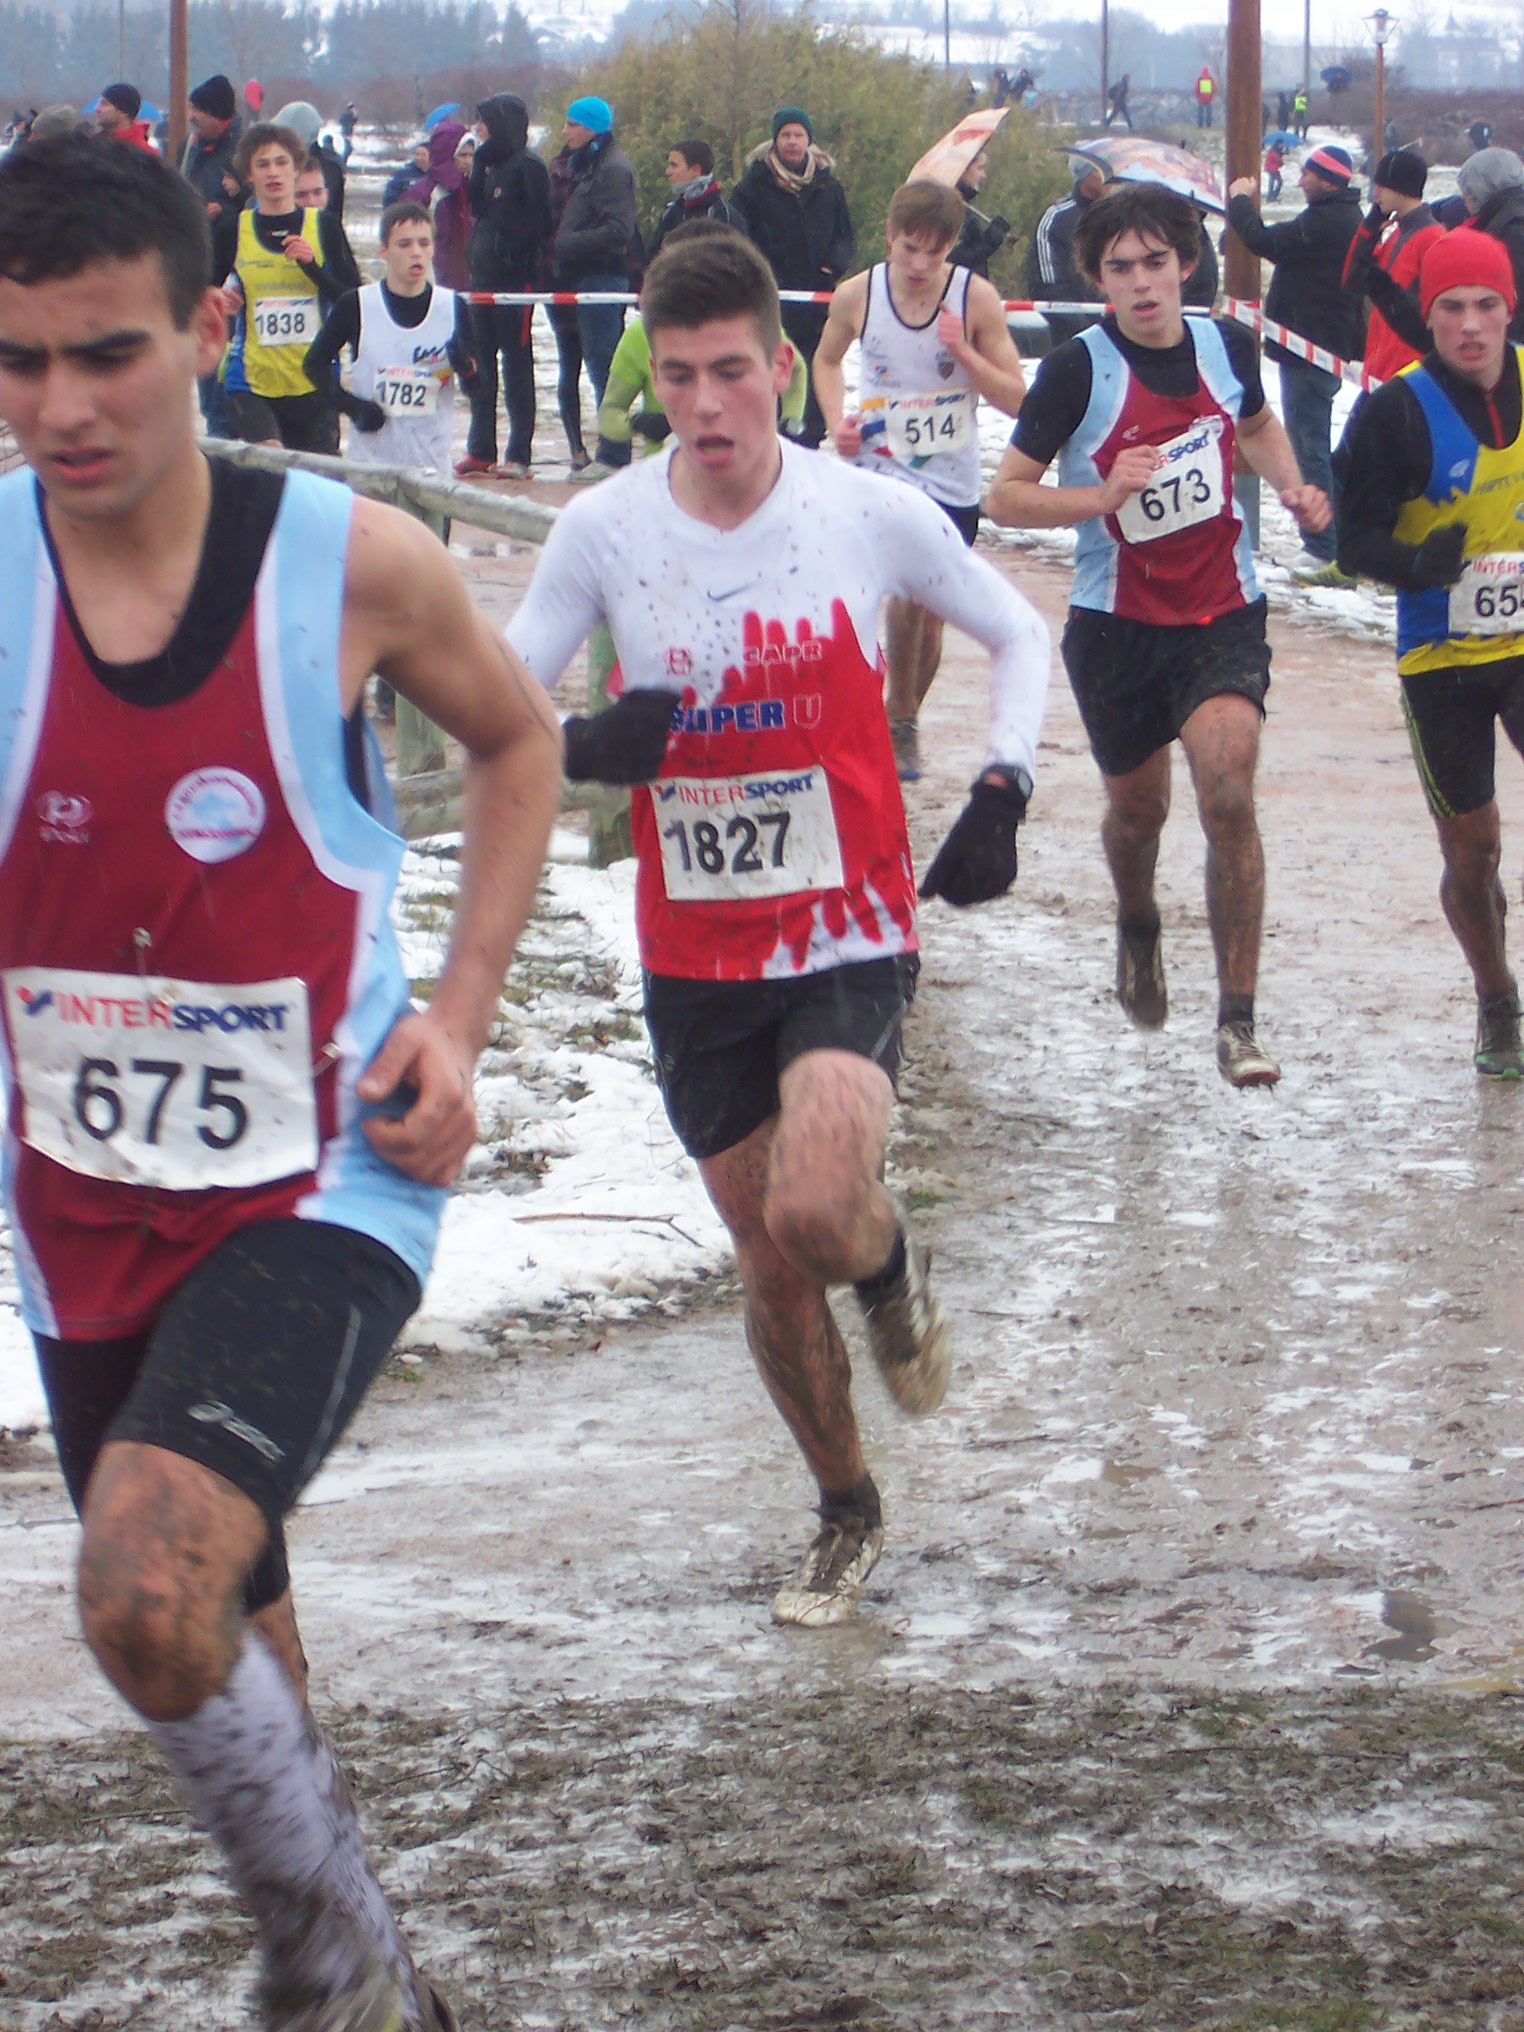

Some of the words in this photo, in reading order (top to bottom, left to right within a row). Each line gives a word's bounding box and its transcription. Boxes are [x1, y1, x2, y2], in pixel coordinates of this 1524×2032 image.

[255, 312, 305, 336] 1838
[376, 380, 427, 407] 1782
[905, 412, 956, 445] 514
[1158, 428, 1210, 469] RSPORT
[1140, 467, 1211, 522] 673
[1475, 584, 1524, 618] 65
[670, 700, 786, 734] SUPER
[793, 692, 822, 730] U
[678, 773, 814, 806] INTERSPORT
[663, 811, 791, 875] 1827
[55, 991, 289, 1034] INTERSPORT
[73, 1054, 247, 1151] 675
